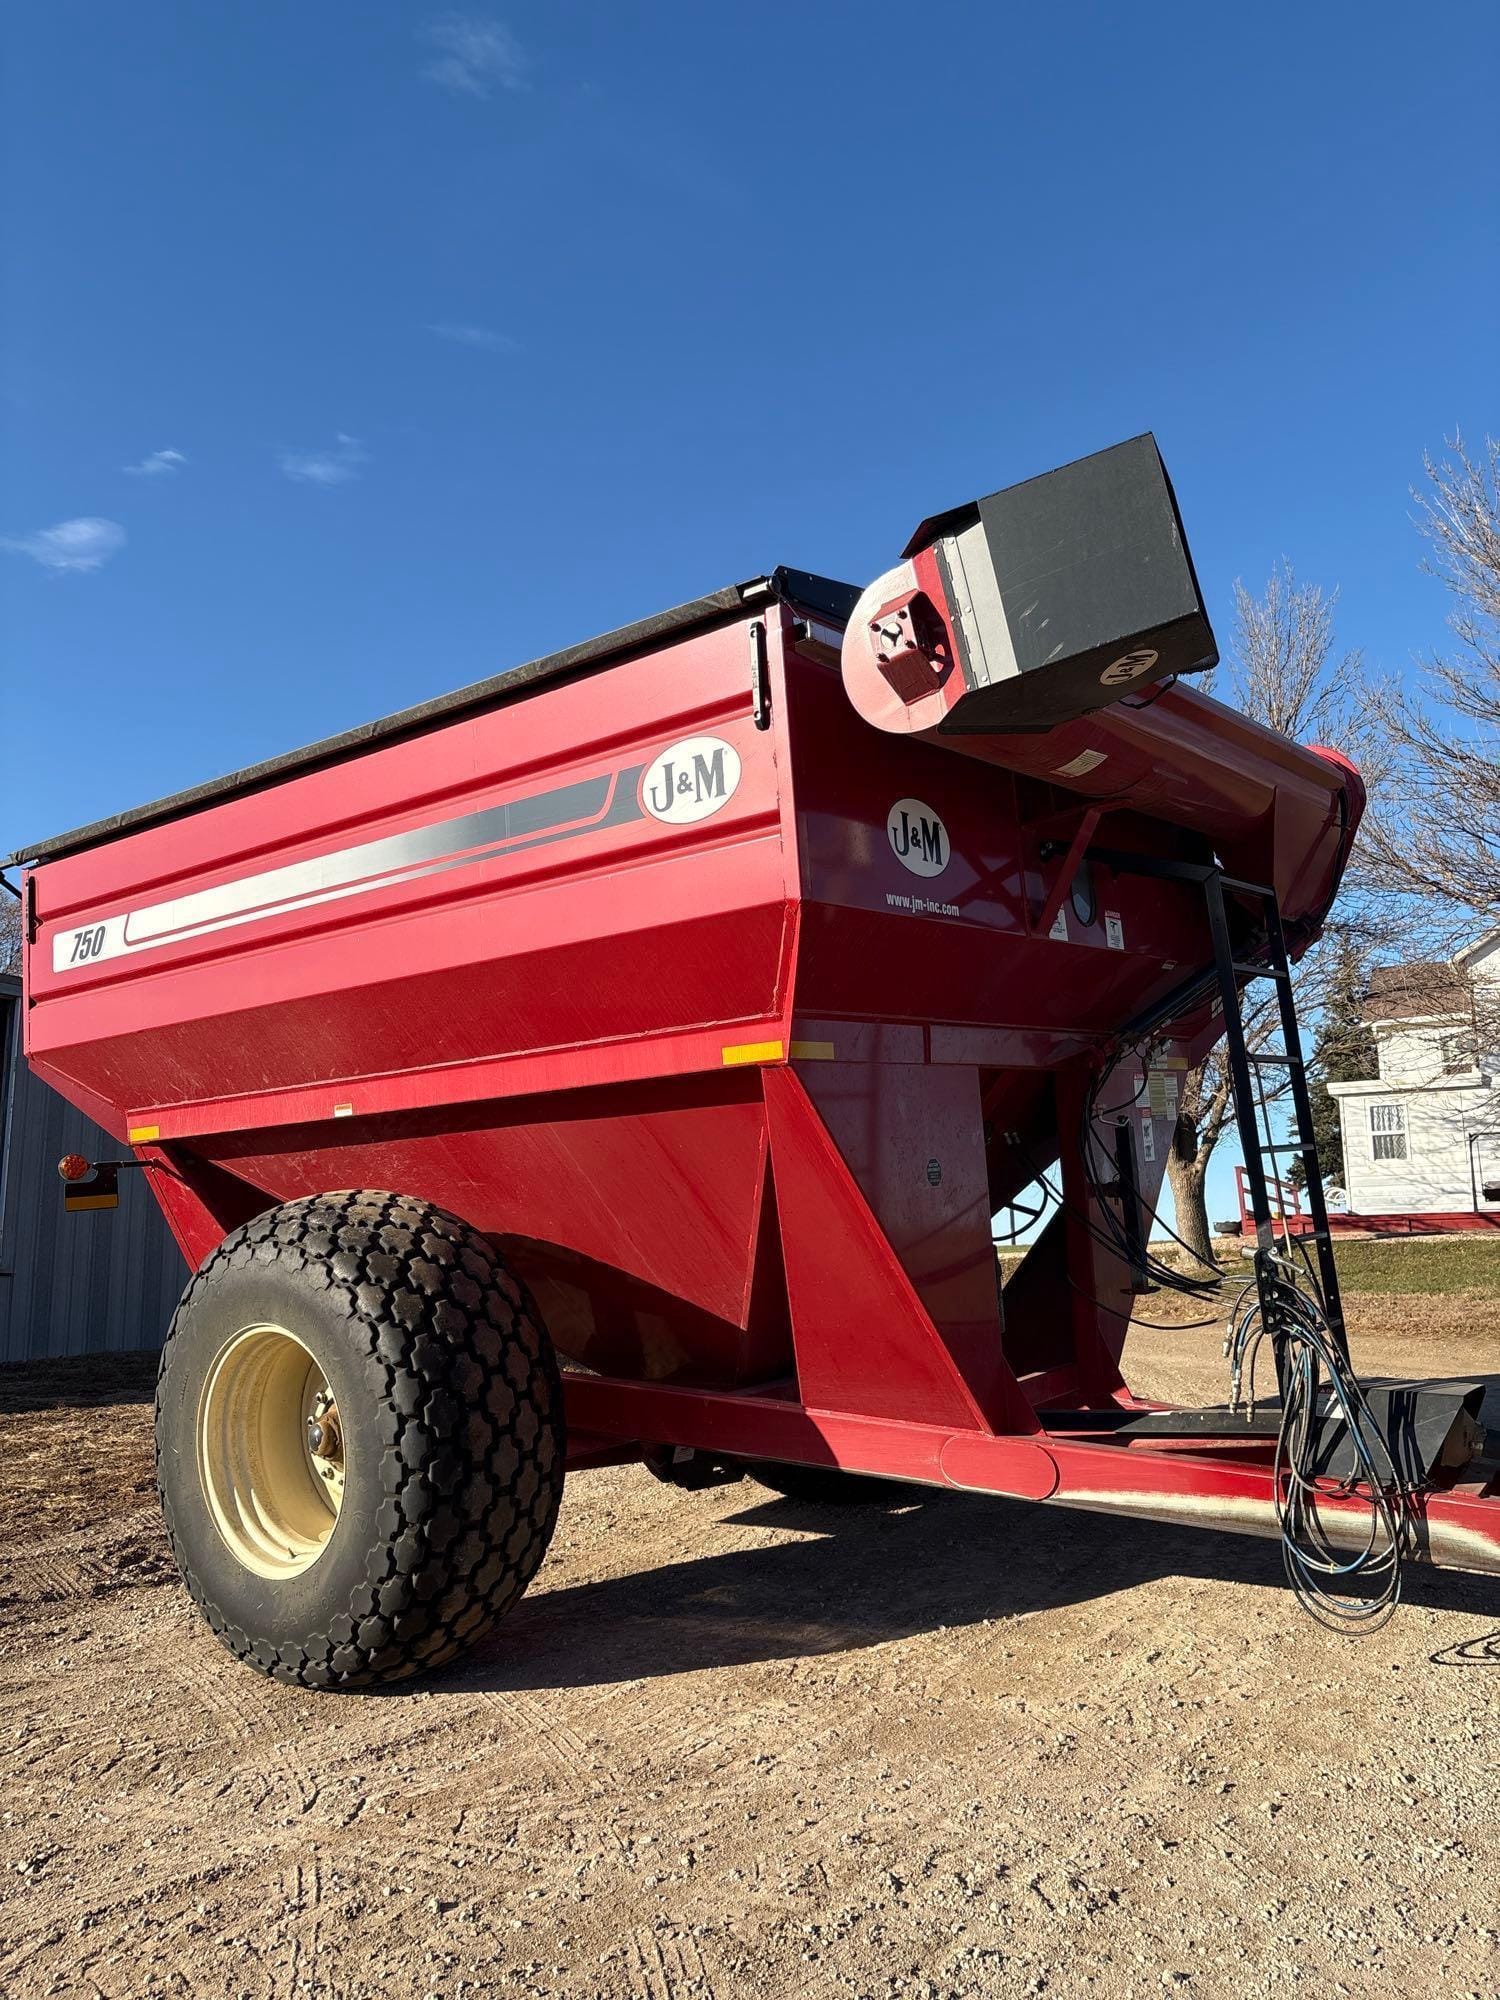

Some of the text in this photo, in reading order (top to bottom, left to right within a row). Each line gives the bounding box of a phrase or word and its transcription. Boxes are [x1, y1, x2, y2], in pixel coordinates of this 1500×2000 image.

[1105, 653, 1156, 683] J&M
[649, 747, 727, 813] J&M
[892, 810, 943, 866] J&M
[886, 893, 960, 917] www.jm-inc.com
[70, 925, 106, 963] 750
